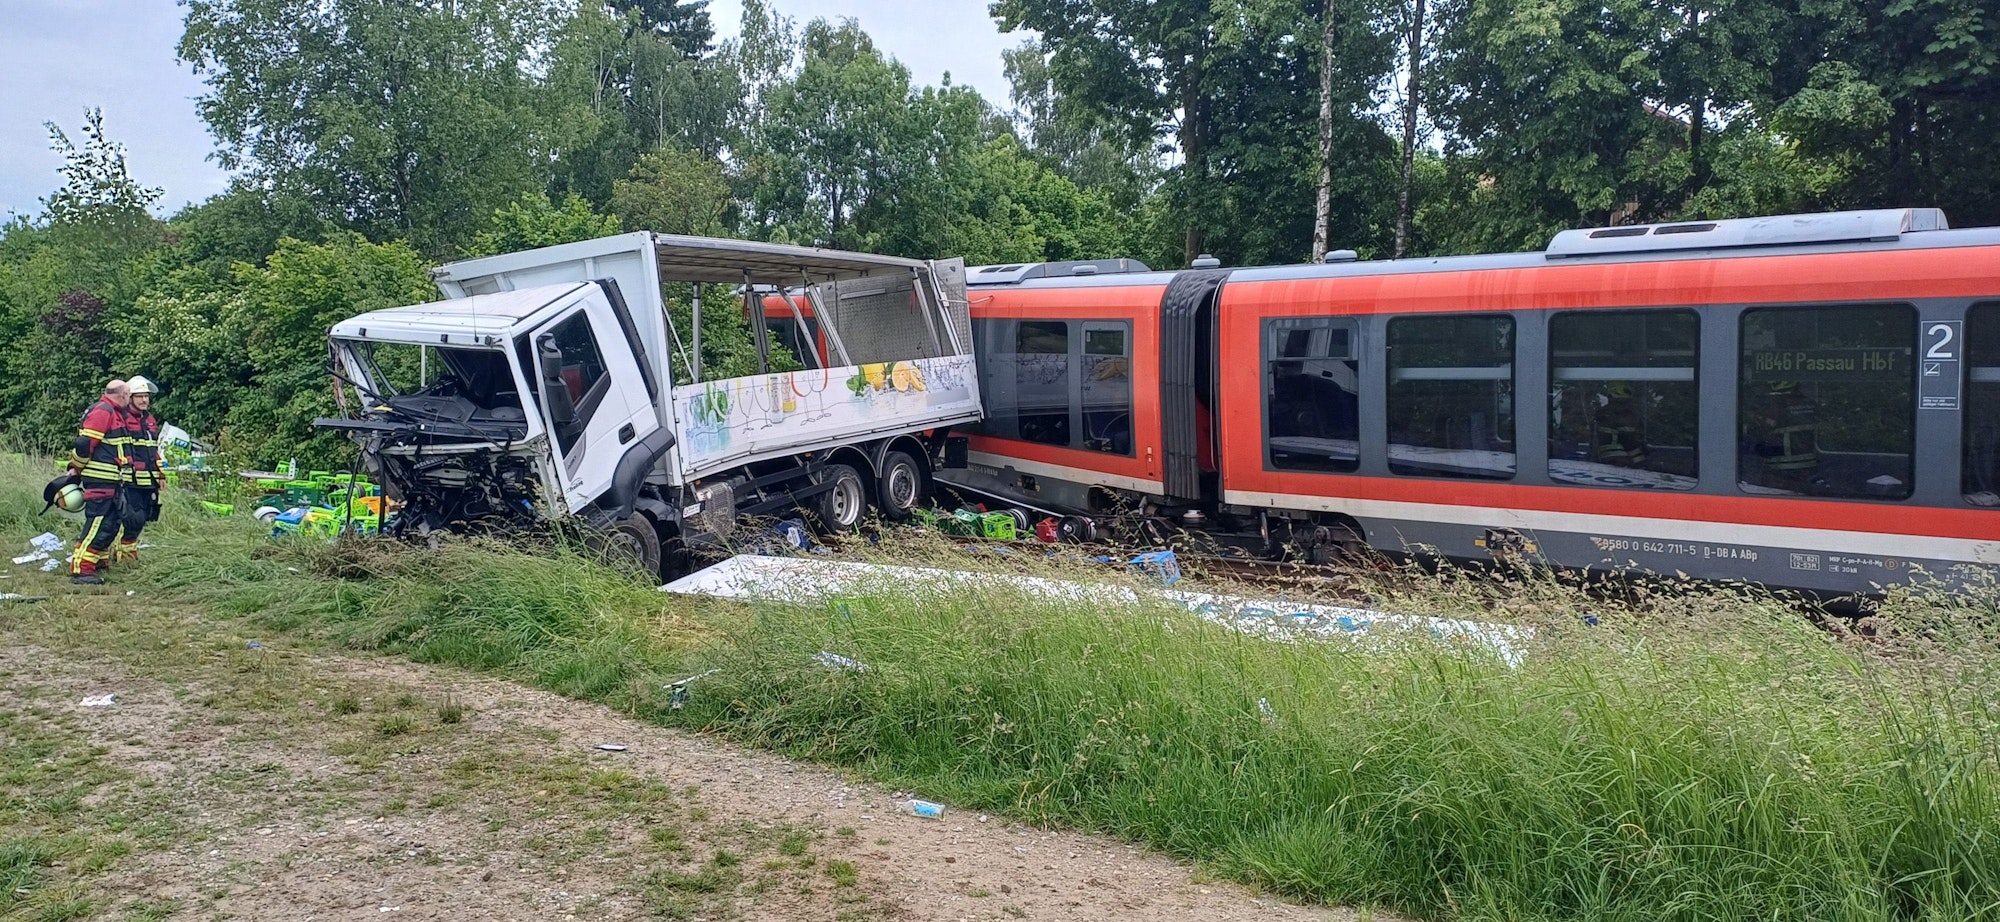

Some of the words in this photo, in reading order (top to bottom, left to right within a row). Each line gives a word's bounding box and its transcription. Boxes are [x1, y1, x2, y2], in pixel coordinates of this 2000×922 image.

[1927, 324, 1953, 358] 2
[1756, 352, 1792, 371] RB46
[1796, 352, 1854, 370] Passau
[1862, 351, 1896, 370] Hbf
[1632, 541, 1639, 551] 0
[1643, 541, 1664, 553] 642
[1667, 543, 1697, 556] 711-5
[1704, 546, 1729, 558] D-DB
[1731, 549, 1738, 558] A
[1740, 549, 1758, 562] ABp
